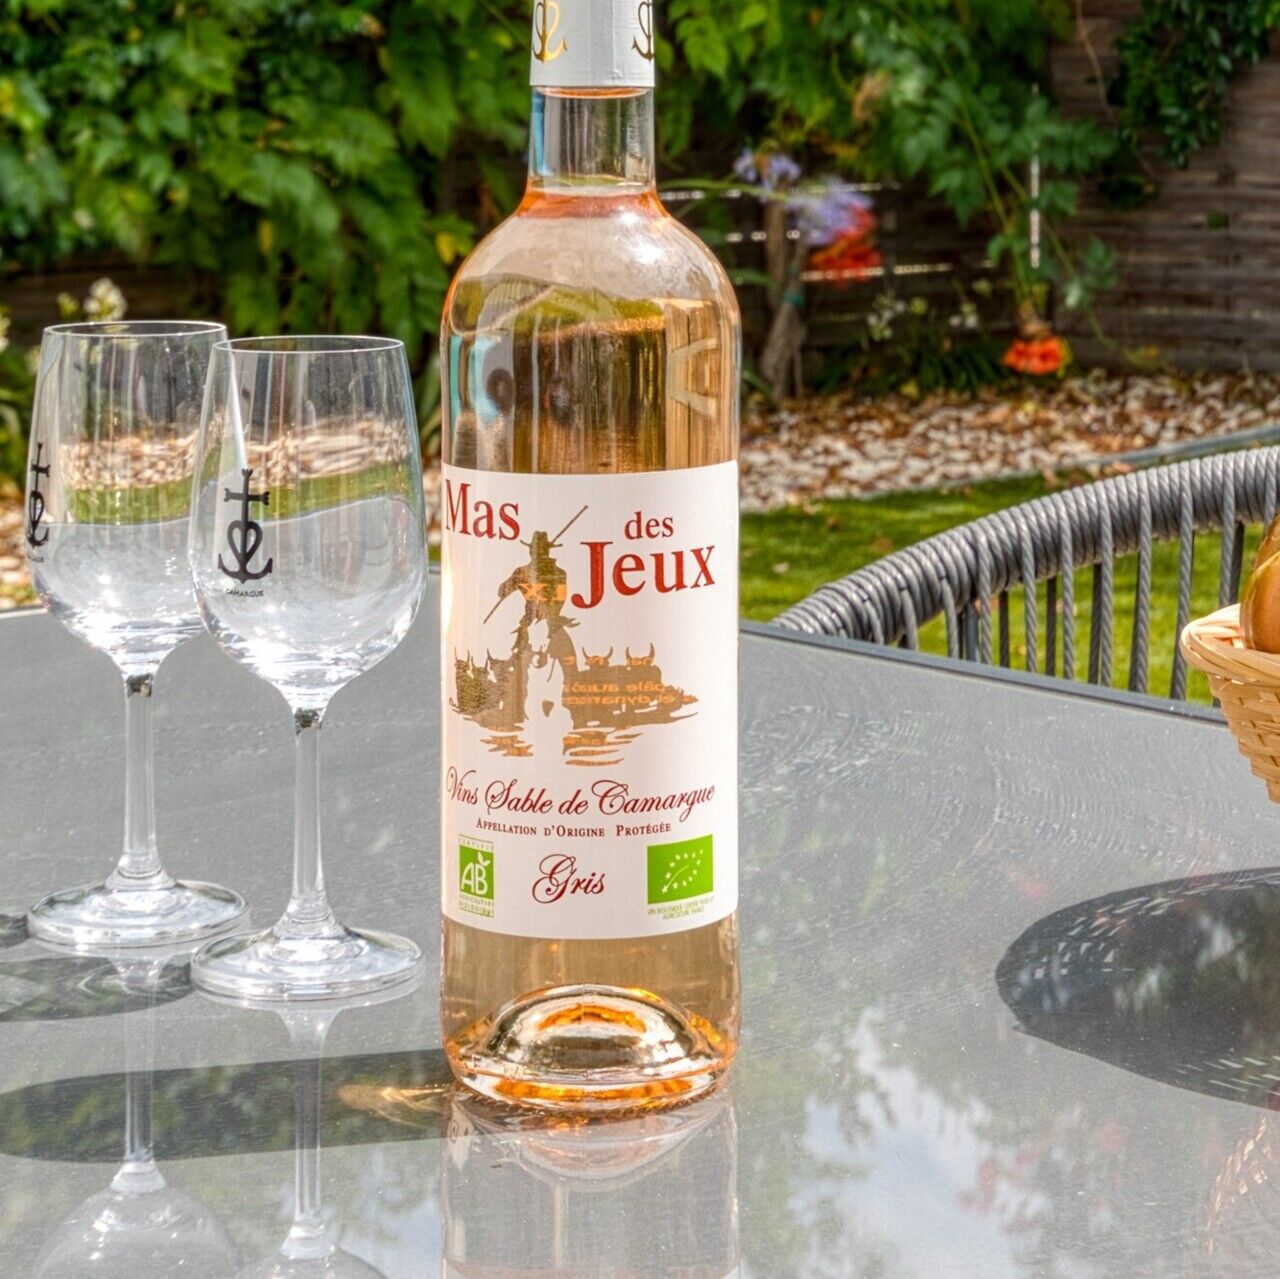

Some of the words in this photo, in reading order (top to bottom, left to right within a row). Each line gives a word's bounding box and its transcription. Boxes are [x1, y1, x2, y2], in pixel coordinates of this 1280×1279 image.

[445, 478, 521, 541] Mas
[624, 511, 674, 540] des
[571, 541, 715, 610] Jeux
[447, 766, 478, 805] Vins
[485, 778, 554, 816] Sable
[558, 789, 590, 815] de
[591, 779, 716, 823] Camargue
[461, 862, 489, 896] AB
[532, 853, 606, 904] Gris
